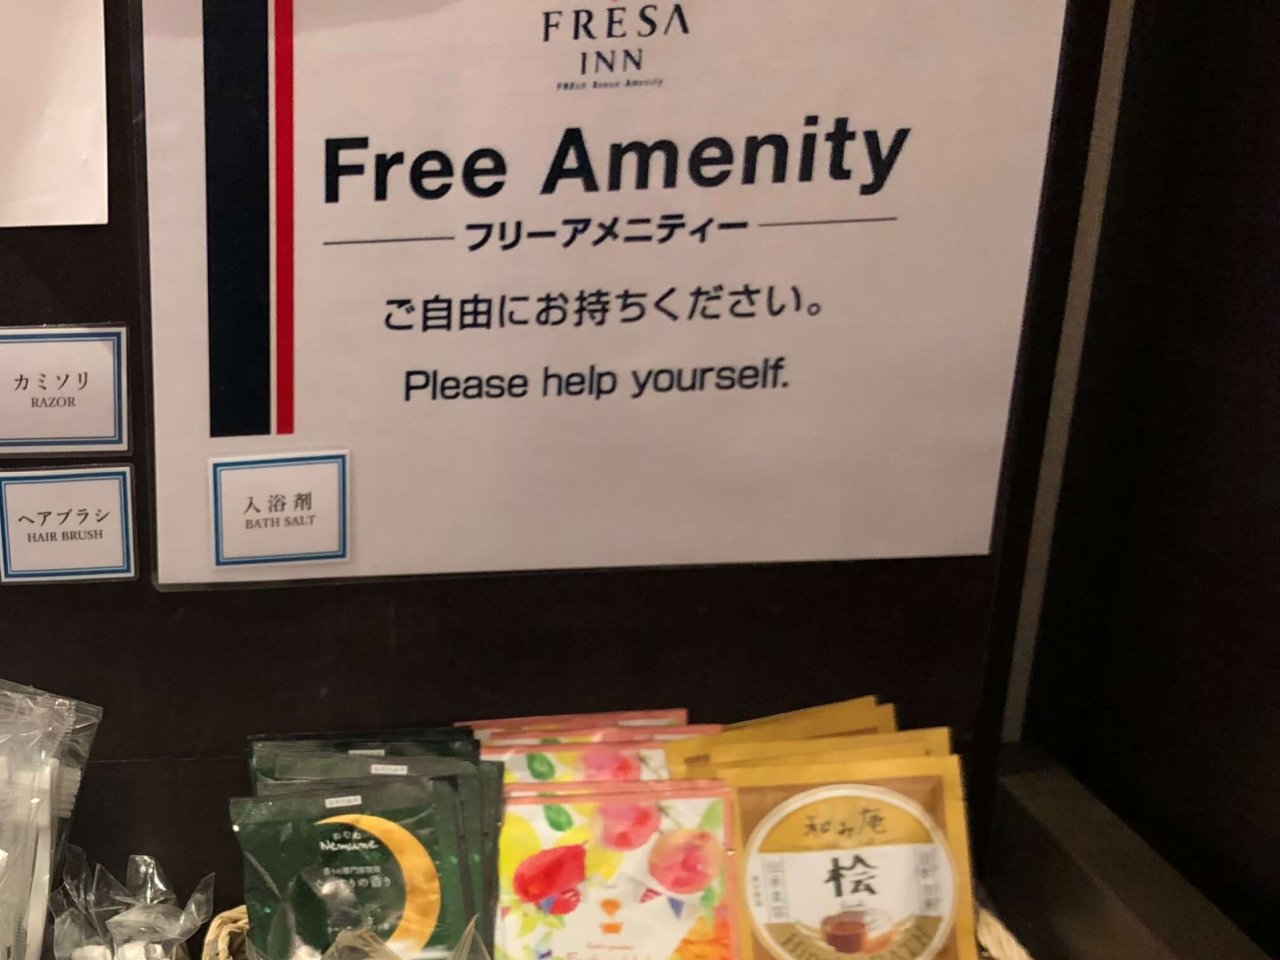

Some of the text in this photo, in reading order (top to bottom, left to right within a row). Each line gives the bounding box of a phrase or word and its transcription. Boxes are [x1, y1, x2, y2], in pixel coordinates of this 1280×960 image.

[581, 48, 643, 75] INN
[322, 116, 913, 203] Free Amenity
[465, 214, 750, 253] フリーアメニティー
[381, 282, 828, 334] ご自由にお持ちください。
[13, 371, 90, 392] カミソリ
[403, 356, 791, 402] Please help yourself.
[30, 395, 77, 408] RAZOR
[242, 492, 314, 516] 入浴剤
[18, 507, 111, 527] ヘアブラシ
[245, 514, 317, 530] BATH SALT
[27, 528, 104, 543] HAIR BRUSH
